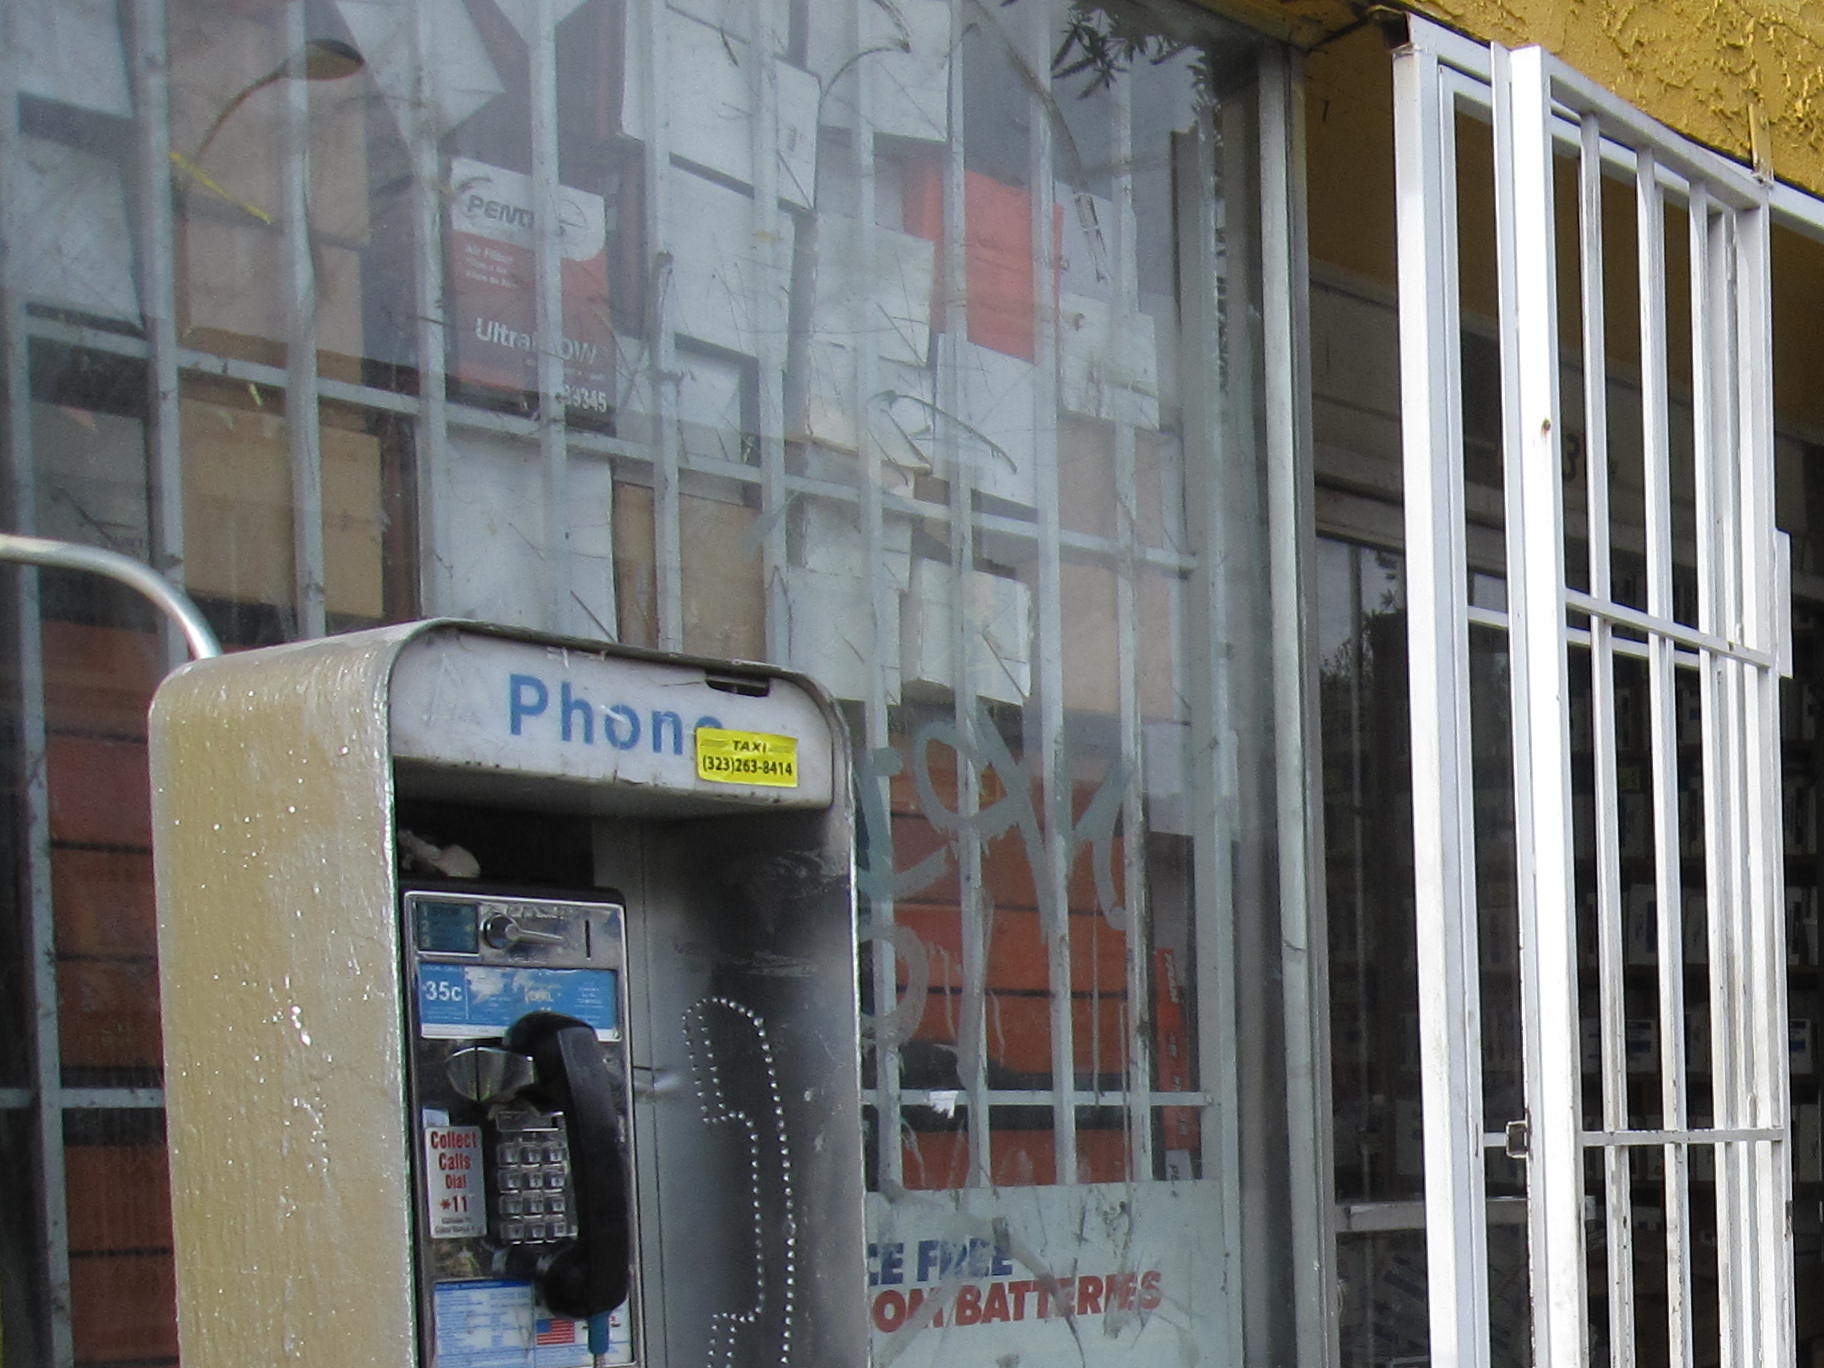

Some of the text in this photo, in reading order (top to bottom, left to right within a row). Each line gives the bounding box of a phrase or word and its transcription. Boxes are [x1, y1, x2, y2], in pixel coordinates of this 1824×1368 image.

[507, 673, 724, 756] Phon
[731, 740, 768, 754] TAXI
[702, 755, 794, 778] (323)263-8414
[430, 1131, 478, 1150] Collect
[438, 1152, 472, 1171] Calls
[445, 1173, 467, 1190] Dial
[955, 1269, 1163, 1327] BATTERIES
